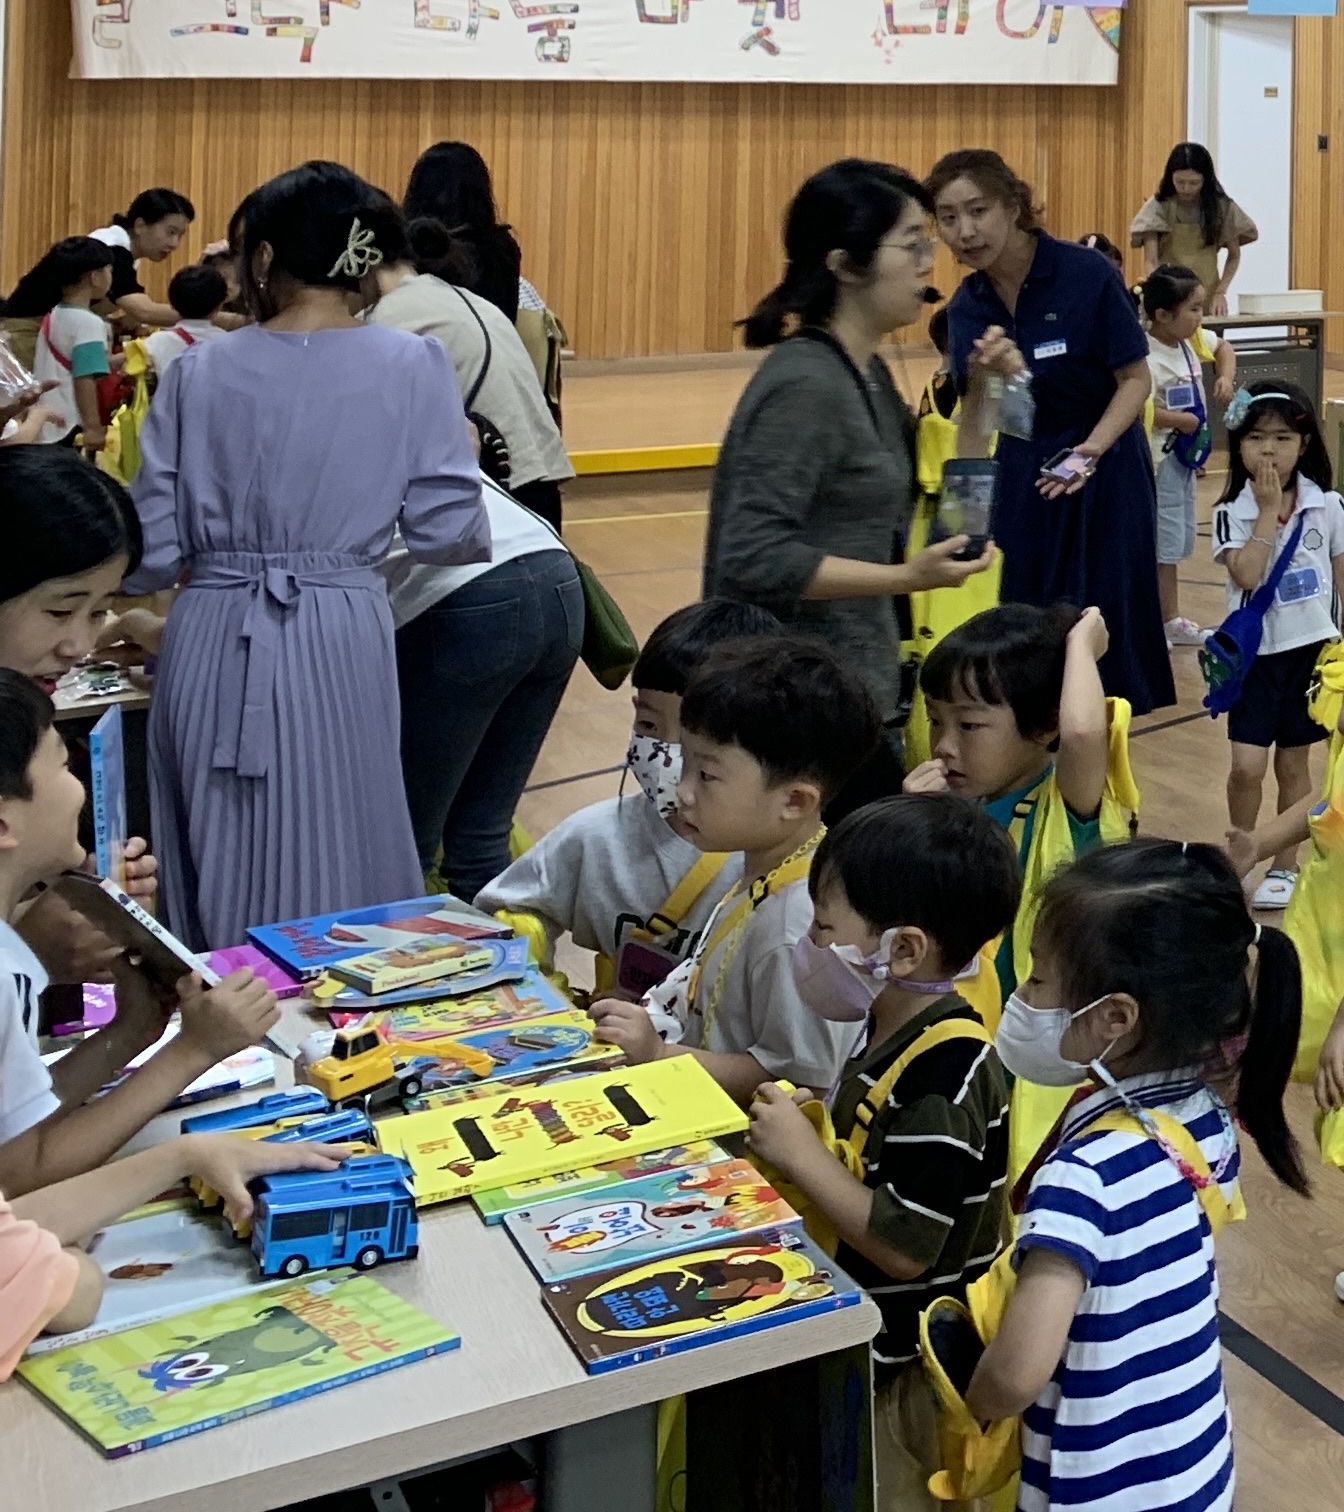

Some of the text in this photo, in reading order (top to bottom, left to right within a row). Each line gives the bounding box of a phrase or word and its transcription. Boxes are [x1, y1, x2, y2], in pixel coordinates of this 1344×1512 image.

[491, 1117, 535, 1142] 나만
[416, 1137, 455, 1155] 왜
[359, 1230, 380, 1242] 120
[601, 1291, 648, 1330] 따라가면
[645, 1304, 680, 1319] 안
